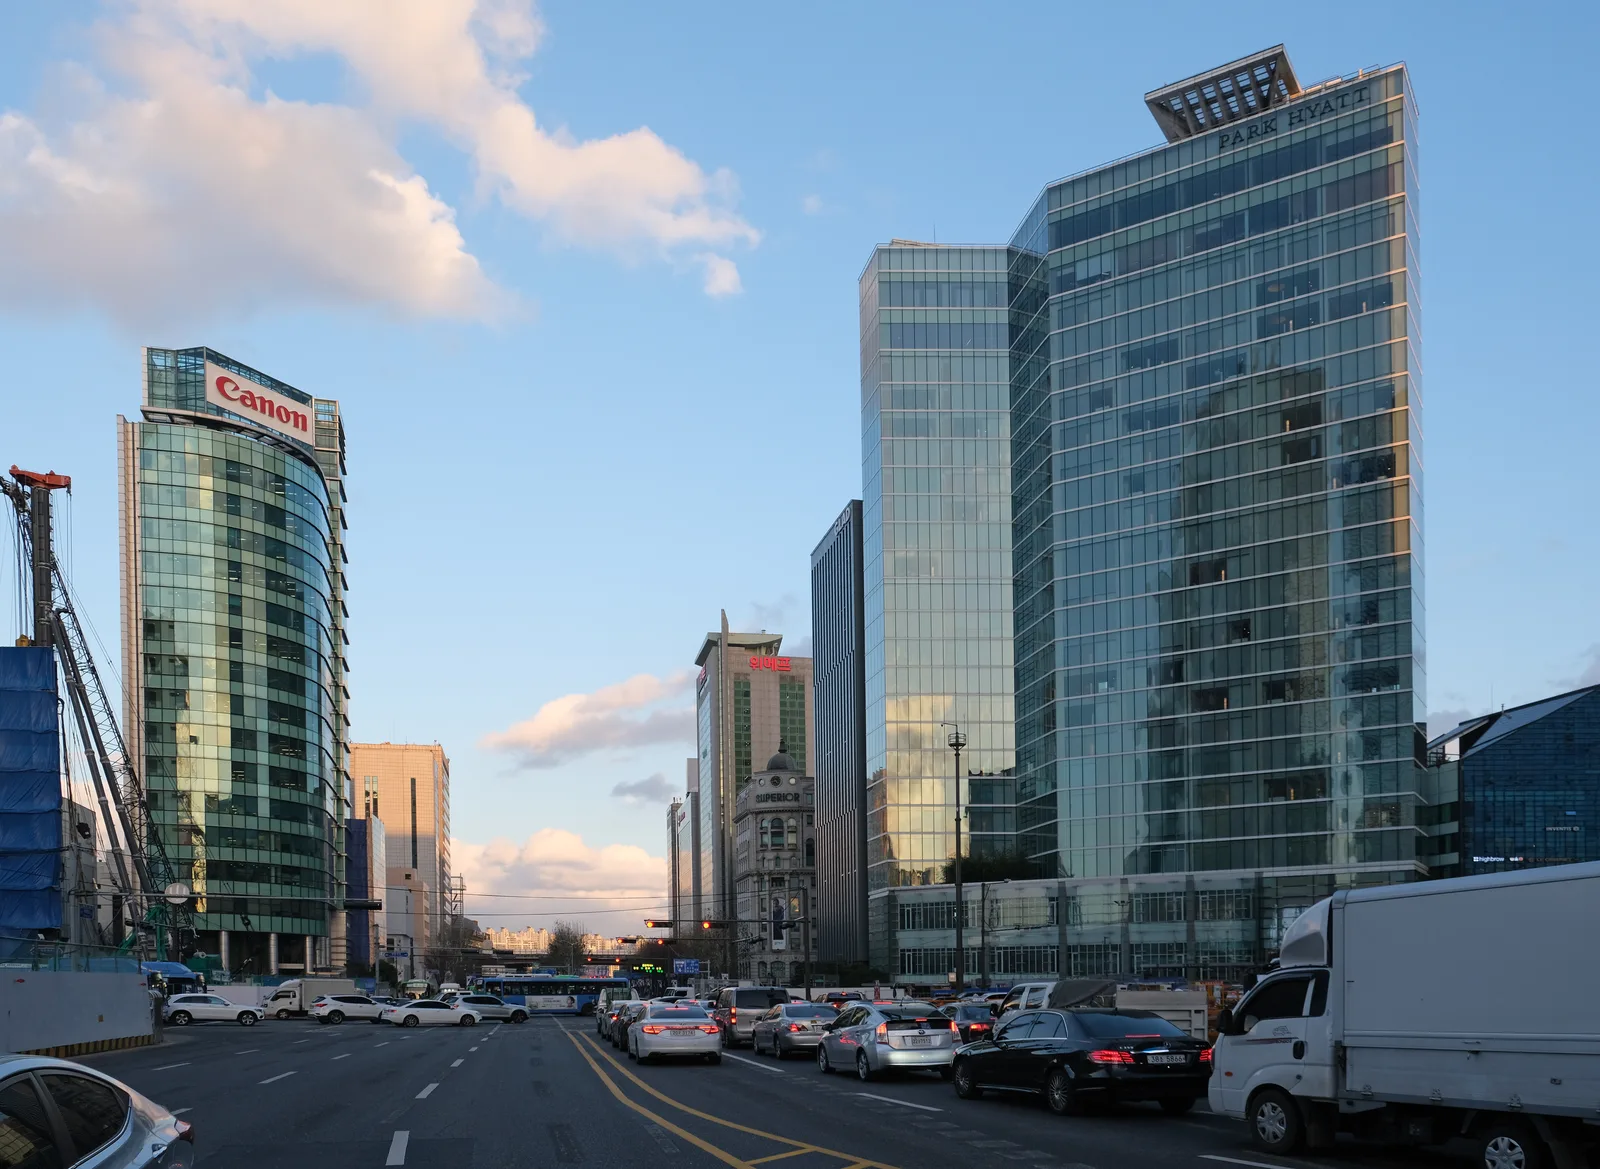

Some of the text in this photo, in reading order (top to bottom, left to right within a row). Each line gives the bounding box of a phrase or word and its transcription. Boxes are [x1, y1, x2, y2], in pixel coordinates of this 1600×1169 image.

[1219, 87, 1370, 148] PARK HYATT
[215, 376, 308, 432] Canon
[833, 507, 851, 536] GLAD
[749, 655, 792, 672] 위메프
[755, 792, 800, 803] SUPERIOR
[1479, 856, 1505, 864] highbrow
